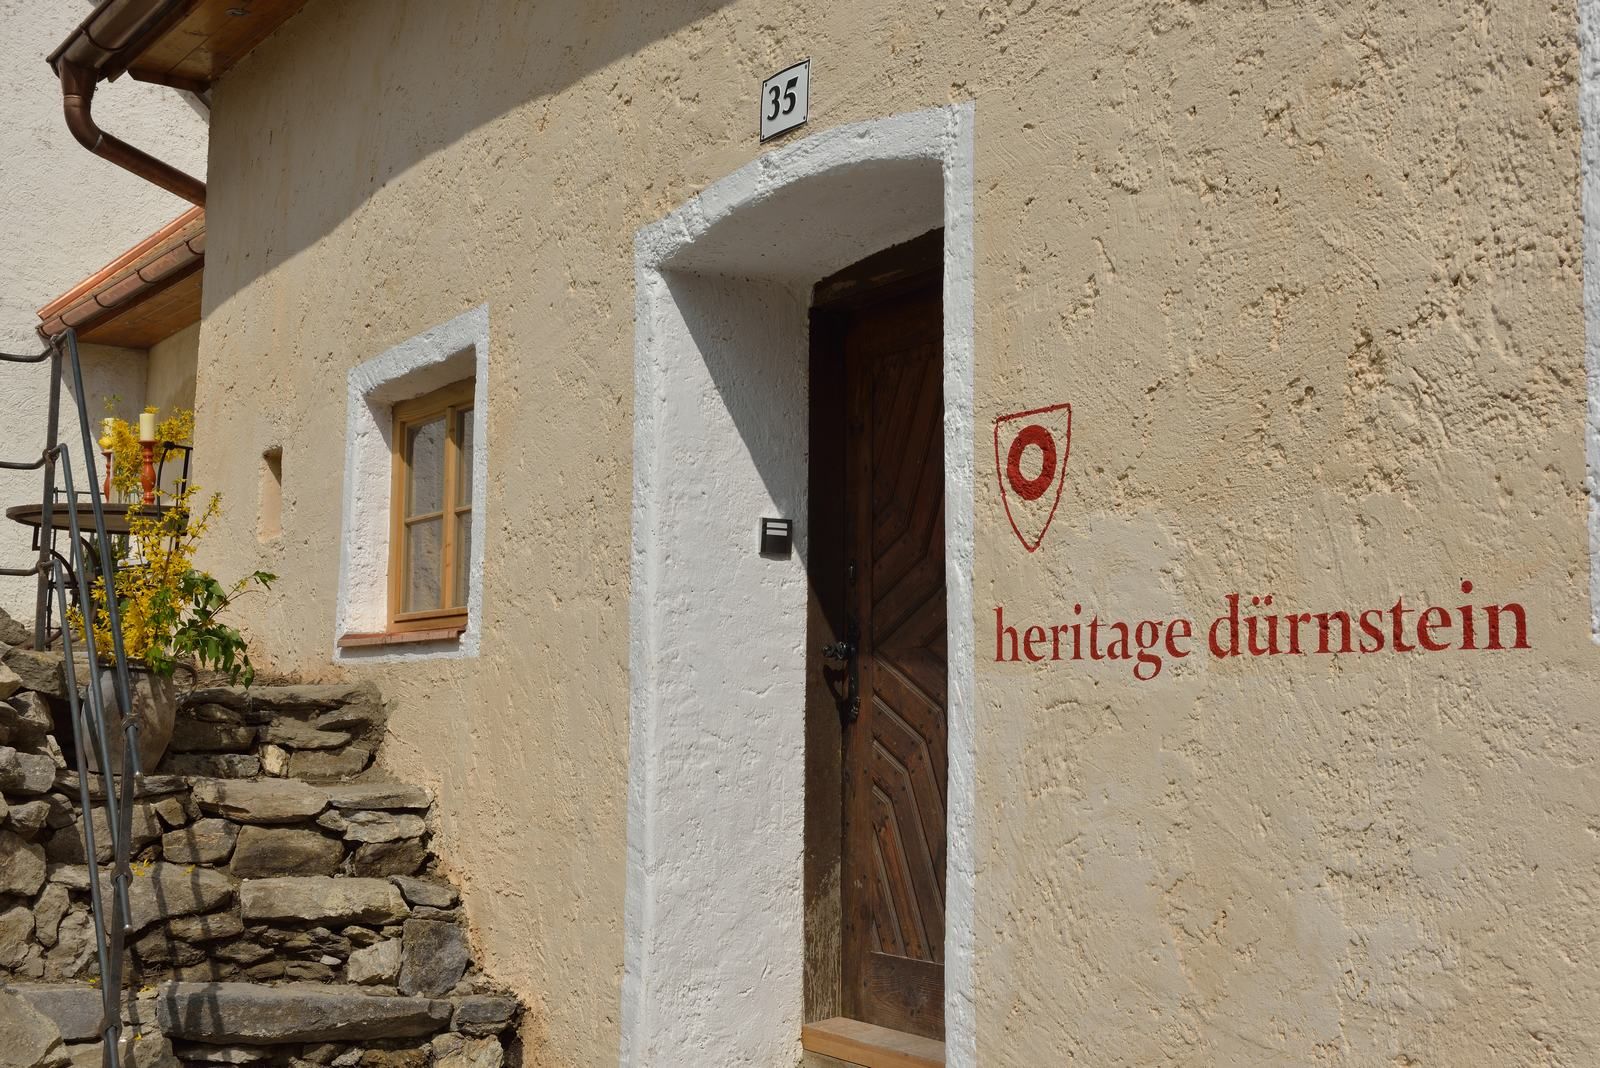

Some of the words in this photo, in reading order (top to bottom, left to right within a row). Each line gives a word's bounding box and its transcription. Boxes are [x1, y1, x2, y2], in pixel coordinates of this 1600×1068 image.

[767, 76, 799, 121] 35
[993, 604, 1192, 681] heritage
[1207, 579, 1532, 659] dürnstein
